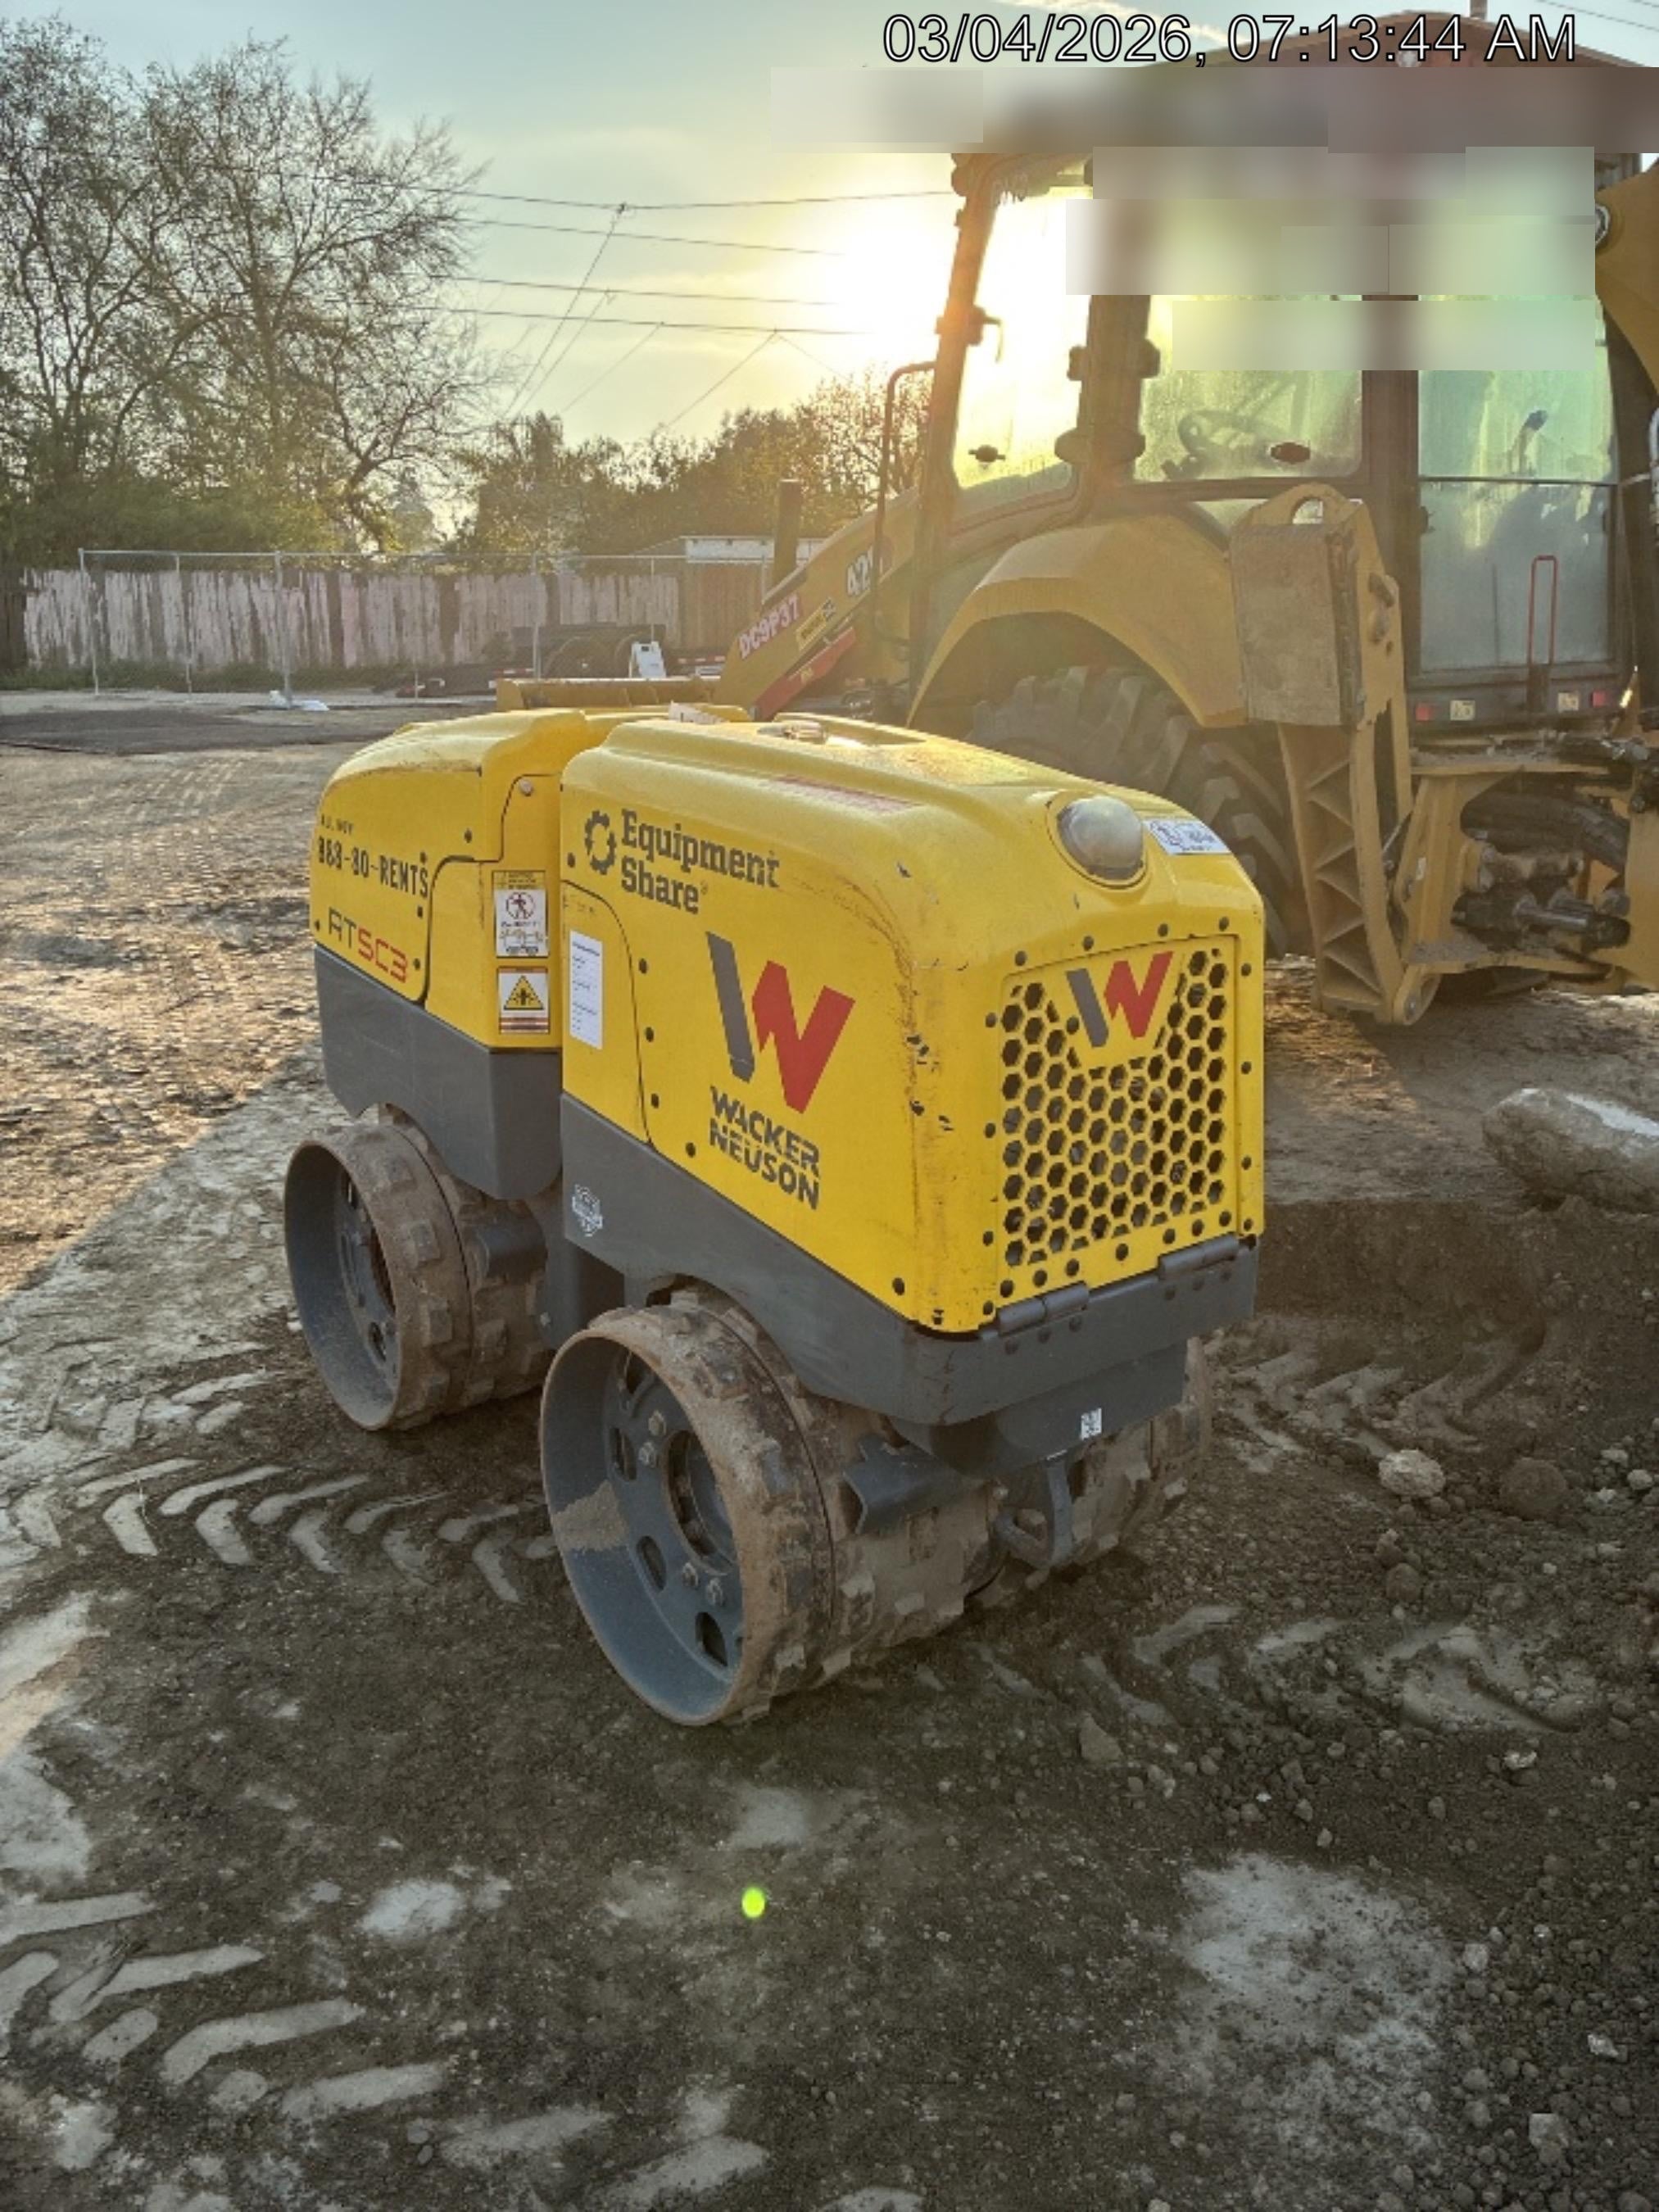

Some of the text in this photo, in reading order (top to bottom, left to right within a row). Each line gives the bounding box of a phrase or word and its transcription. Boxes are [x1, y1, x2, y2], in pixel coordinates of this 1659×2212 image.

[622, 809, 779, 888] Equipment
[622, 856, 700, 914] Share
[709, 1086, 819, 1175] WACKER
[709, 1118, 818, 1210] NEUSON
